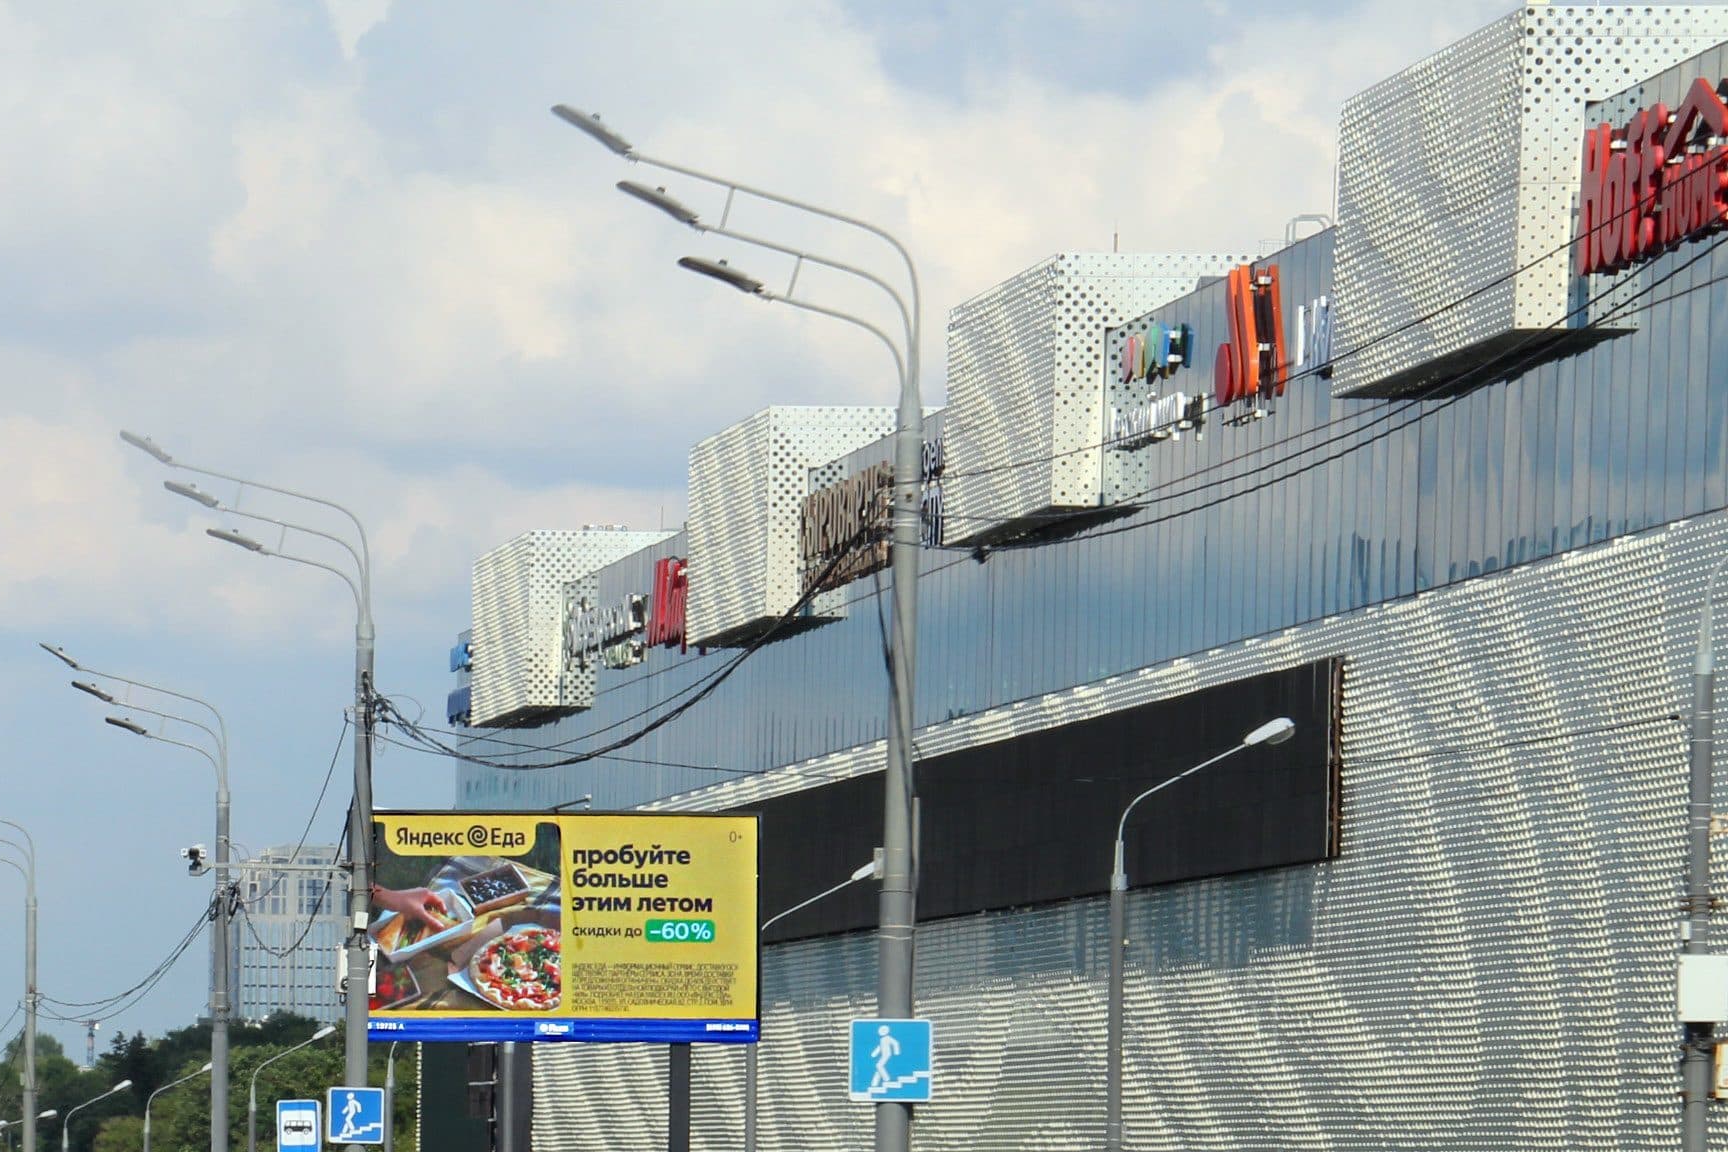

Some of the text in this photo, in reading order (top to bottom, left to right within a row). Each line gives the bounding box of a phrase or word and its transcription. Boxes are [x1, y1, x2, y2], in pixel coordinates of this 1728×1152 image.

[396, 827, 526, 848] Яндекс Еда
[729, 831, 743, 843] 0+
[572, 844, 691, 868] пробуйте
[572, 868, 669, 888] больше
[571, 896, 713, 912] этим летом
[571, 922, 711, 940] скидки до -60%
